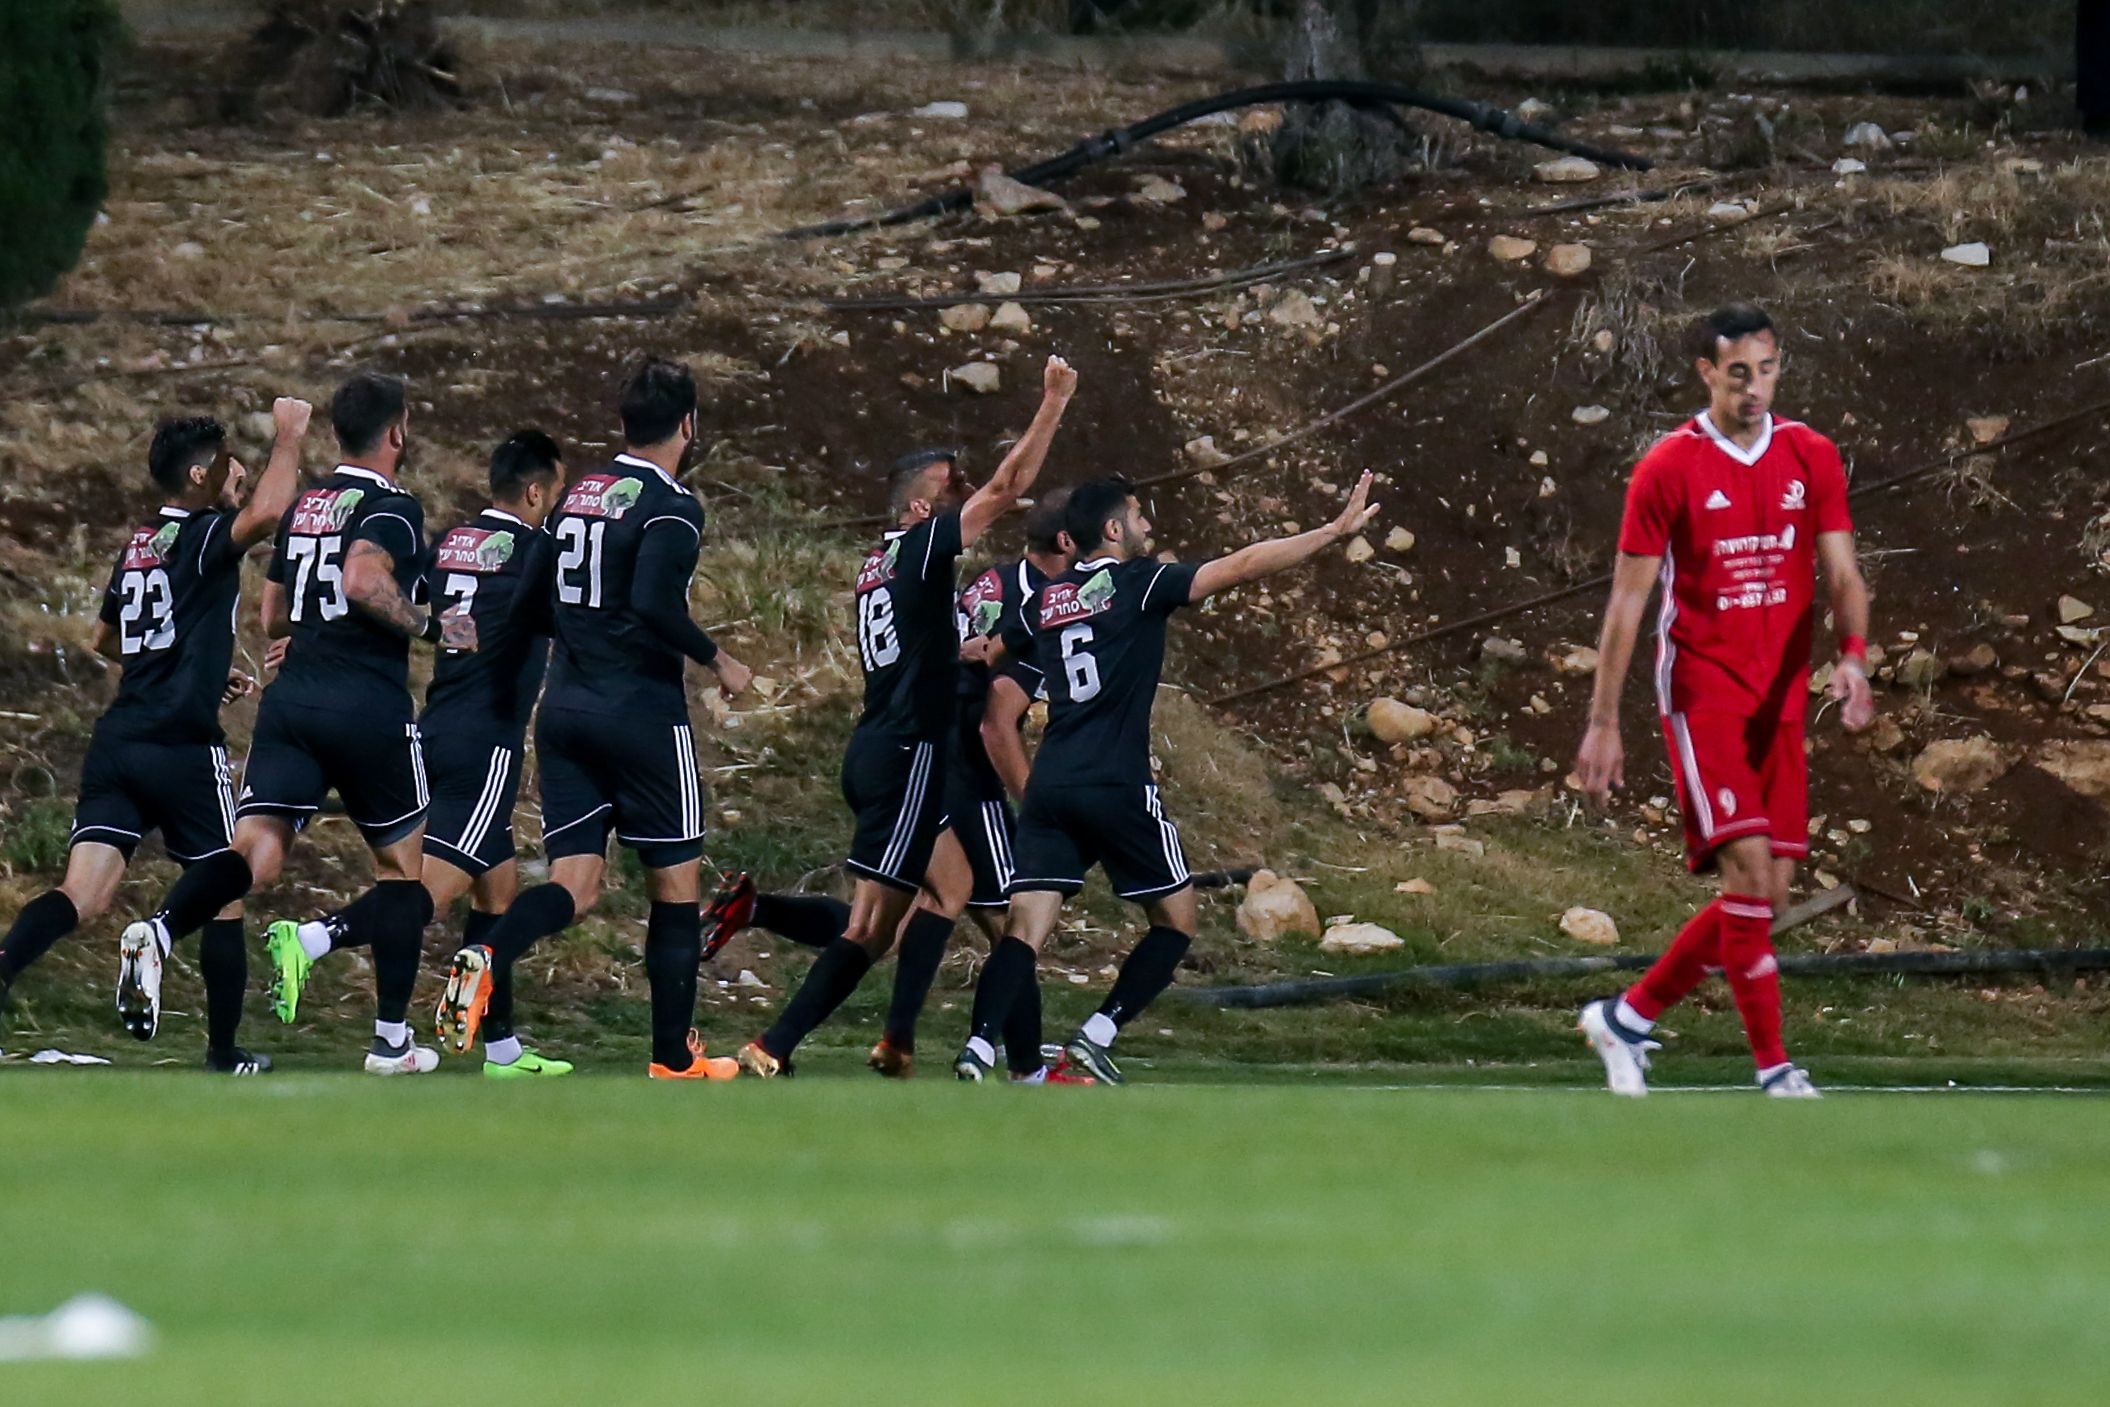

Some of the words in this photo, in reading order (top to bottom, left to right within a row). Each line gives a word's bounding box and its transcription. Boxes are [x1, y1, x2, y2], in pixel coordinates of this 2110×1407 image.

[577, 480, 604, 493] אדיב
[579, 495, 600, 507] סחר
[286, 536, 349, 622] 75
[449, 536, 476, 547] אדיב
[453, 551, 477, 563] סחר
[556, 517, 606, 608] 21
[120, 569, 175, 654] 23
[444, 573, 479, 653] 7
[857, 586, 900, 672] 18
[1059, 622, 1102, 703] 6
